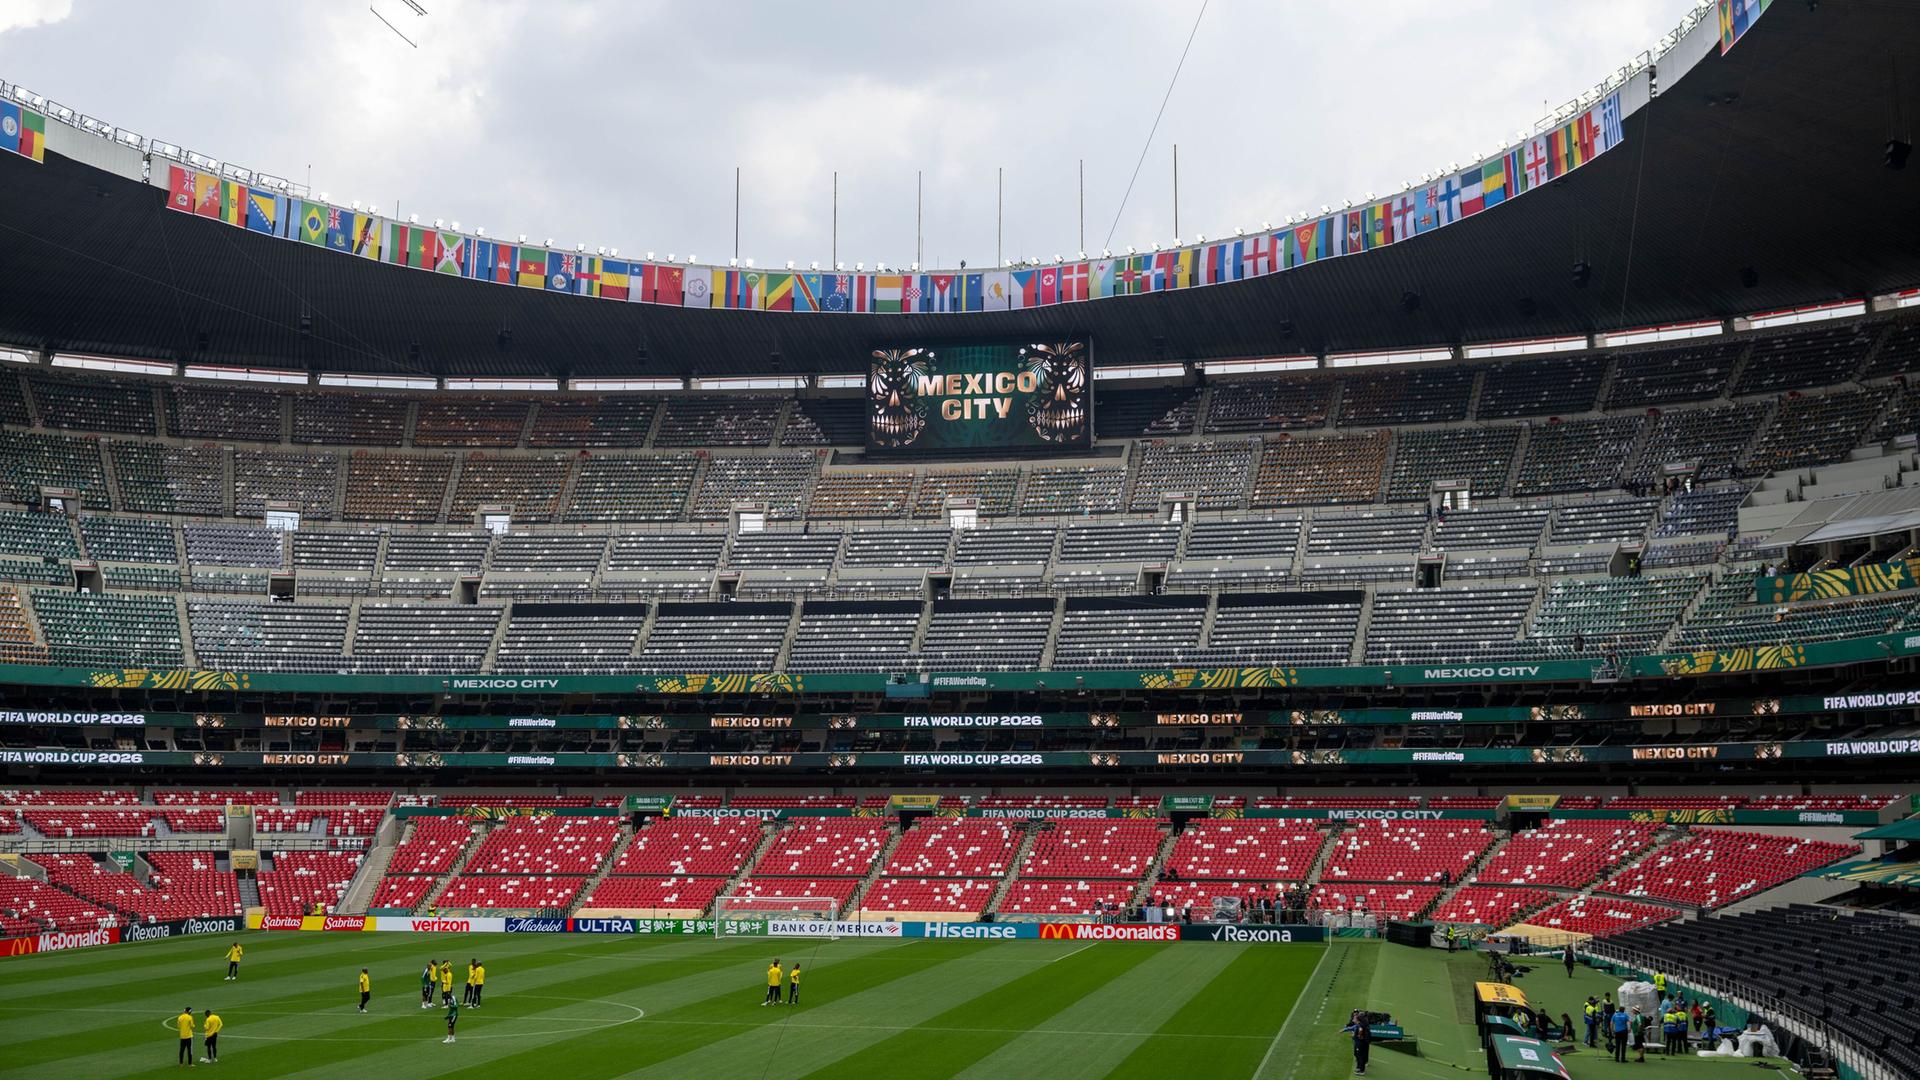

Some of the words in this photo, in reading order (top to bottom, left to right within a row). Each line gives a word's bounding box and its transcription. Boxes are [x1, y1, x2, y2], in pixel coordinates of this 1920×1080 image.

[918, 372, 1036, 396] MEXICO
[942, 398, 1012, 420] CITY
[1425, 667, 1494, 678] MEXICO
[1498, 666, 1539, 676] CITY
[454, 680, 517, 688] MEXICO
[521, 680, 558, 688] CITY
[934, 677, 986, 686] #FIFAWorldCup
[1824, 697, 1847, 709] FIFA
[1848, 694, 1885, 707] WORLD
[1886, 693, 1905, 705] CUP
[1907, 691, 1920, 704] 20
[1631, 704, 1682, 716] MEXICO
[1685, 704, 1716, 714] CITY
[0, 712, 25, 722] FIFA
[27, 713, 72, 723] WORLD
[74, 714, 99, 723] CUP
[100, 714, 145, 724] 2026
[265, 717, 316, 726] MEXICO
[320, 718, 350, 726] CITY
[904, 717, 929, 726] FIFA
[931, 717, 973, 726] WORLD
[975, 716, 998, 726] CUP
[1001, 716, 1043, 725] 2026
[1158, 714, 1208, 724] MEXICO
[1212, 714, 1242, 723] CITY
[1411, 711, 1462, 721] #FIFAWorldCup
[509, 719, 555, 727] #FIFAWorldCup
[711, 718, 760, 727] MEXICO
[763, 718, 792, 726] CITY
[1633, 747, 1684, 759] MEXICO
[1688, 747, 1717, 757] CITY
[1827, 743, 1850, 755] FIFA
[1851, 741, 1888, 754] WORLD
[1889, 740, 1909, 753] CUP
[24, 752, 69, 762] WORLD
[71, 753, 96, 762] CUP
[98, 753, 144, 763] 2026
[263, 755, 315, 764] MEXICO
[319, 755, 348, 764] CITY
[508, 756, 554, 765] #FIFAWorldCup
[711, 756, 760, 765] MEXICO
[763, 756, 791, 764] CITY
[904, 755, 929, 764] FIFA
[931, 755, 973, 764] WORLD
[975, 755, 999, 764] CUP
[1001, 755, 1043, 764] 2026
[1158, 754, 1209, 763] MEXICO
[1213, 753, 1243, 763] CITY
[1413, 752, 1464, 761] #FIFAWorldCup
[677, 809, 742, 818] MEXICO
[744, 809, 782, 818] CITY
[983, 809, 1005, 818] FIFA
[1007, 809, 1045, 818] WORLD
[1047, 809, 1067, 818] CUP
[1068, 809, 1106, 818] 2026
[1328, 810, 1398, 819] MEXICO
[1402, 810, 1443, 819] CITY
[187, 918, 235, 935] Rexona
[261, 917, 302, 929] Sabritas
[325, 917, 364, 930] Sabritas
[412, 917, 470, 932] verizon
[507, 918, 563, 932] Michelob
[579, 919, 633, 932] ULTRA
[773, 923, 806, 933] BANK
[809, 923, 824, 933] OF
[132, 924, 170, 942] Rexona
[925, 922, 1017, 938] Hisense
[1076, 925, 1176, 940] McDonald's
[1224, 926, 1292, 942] Rexona
[38, 928, 110, 952] McDonald's
